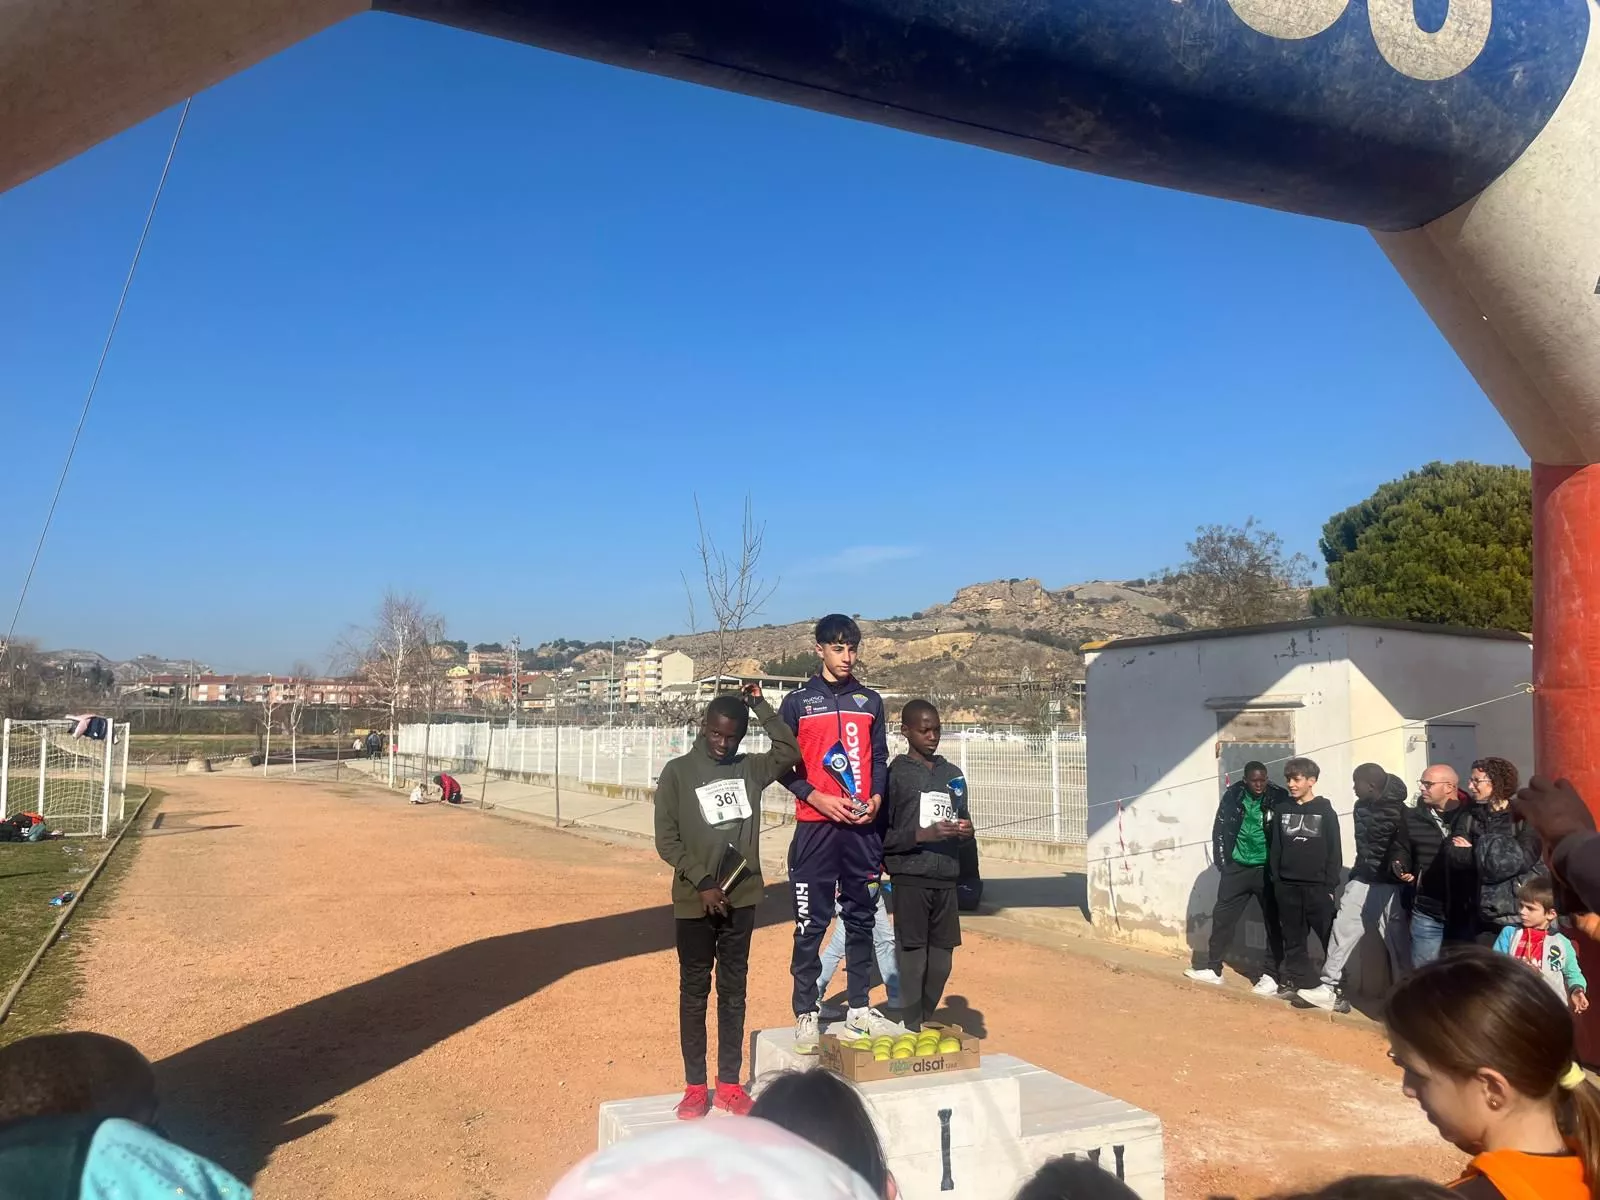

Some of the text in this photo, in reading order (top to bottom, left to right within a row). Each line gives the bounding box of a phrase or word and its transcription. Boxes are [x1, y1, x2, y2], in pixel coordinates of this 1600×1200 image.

[715, 791, 738, 807] 361
[934, 804, 952, 818] 376
[913, 1057, 944, 1073] alsat
